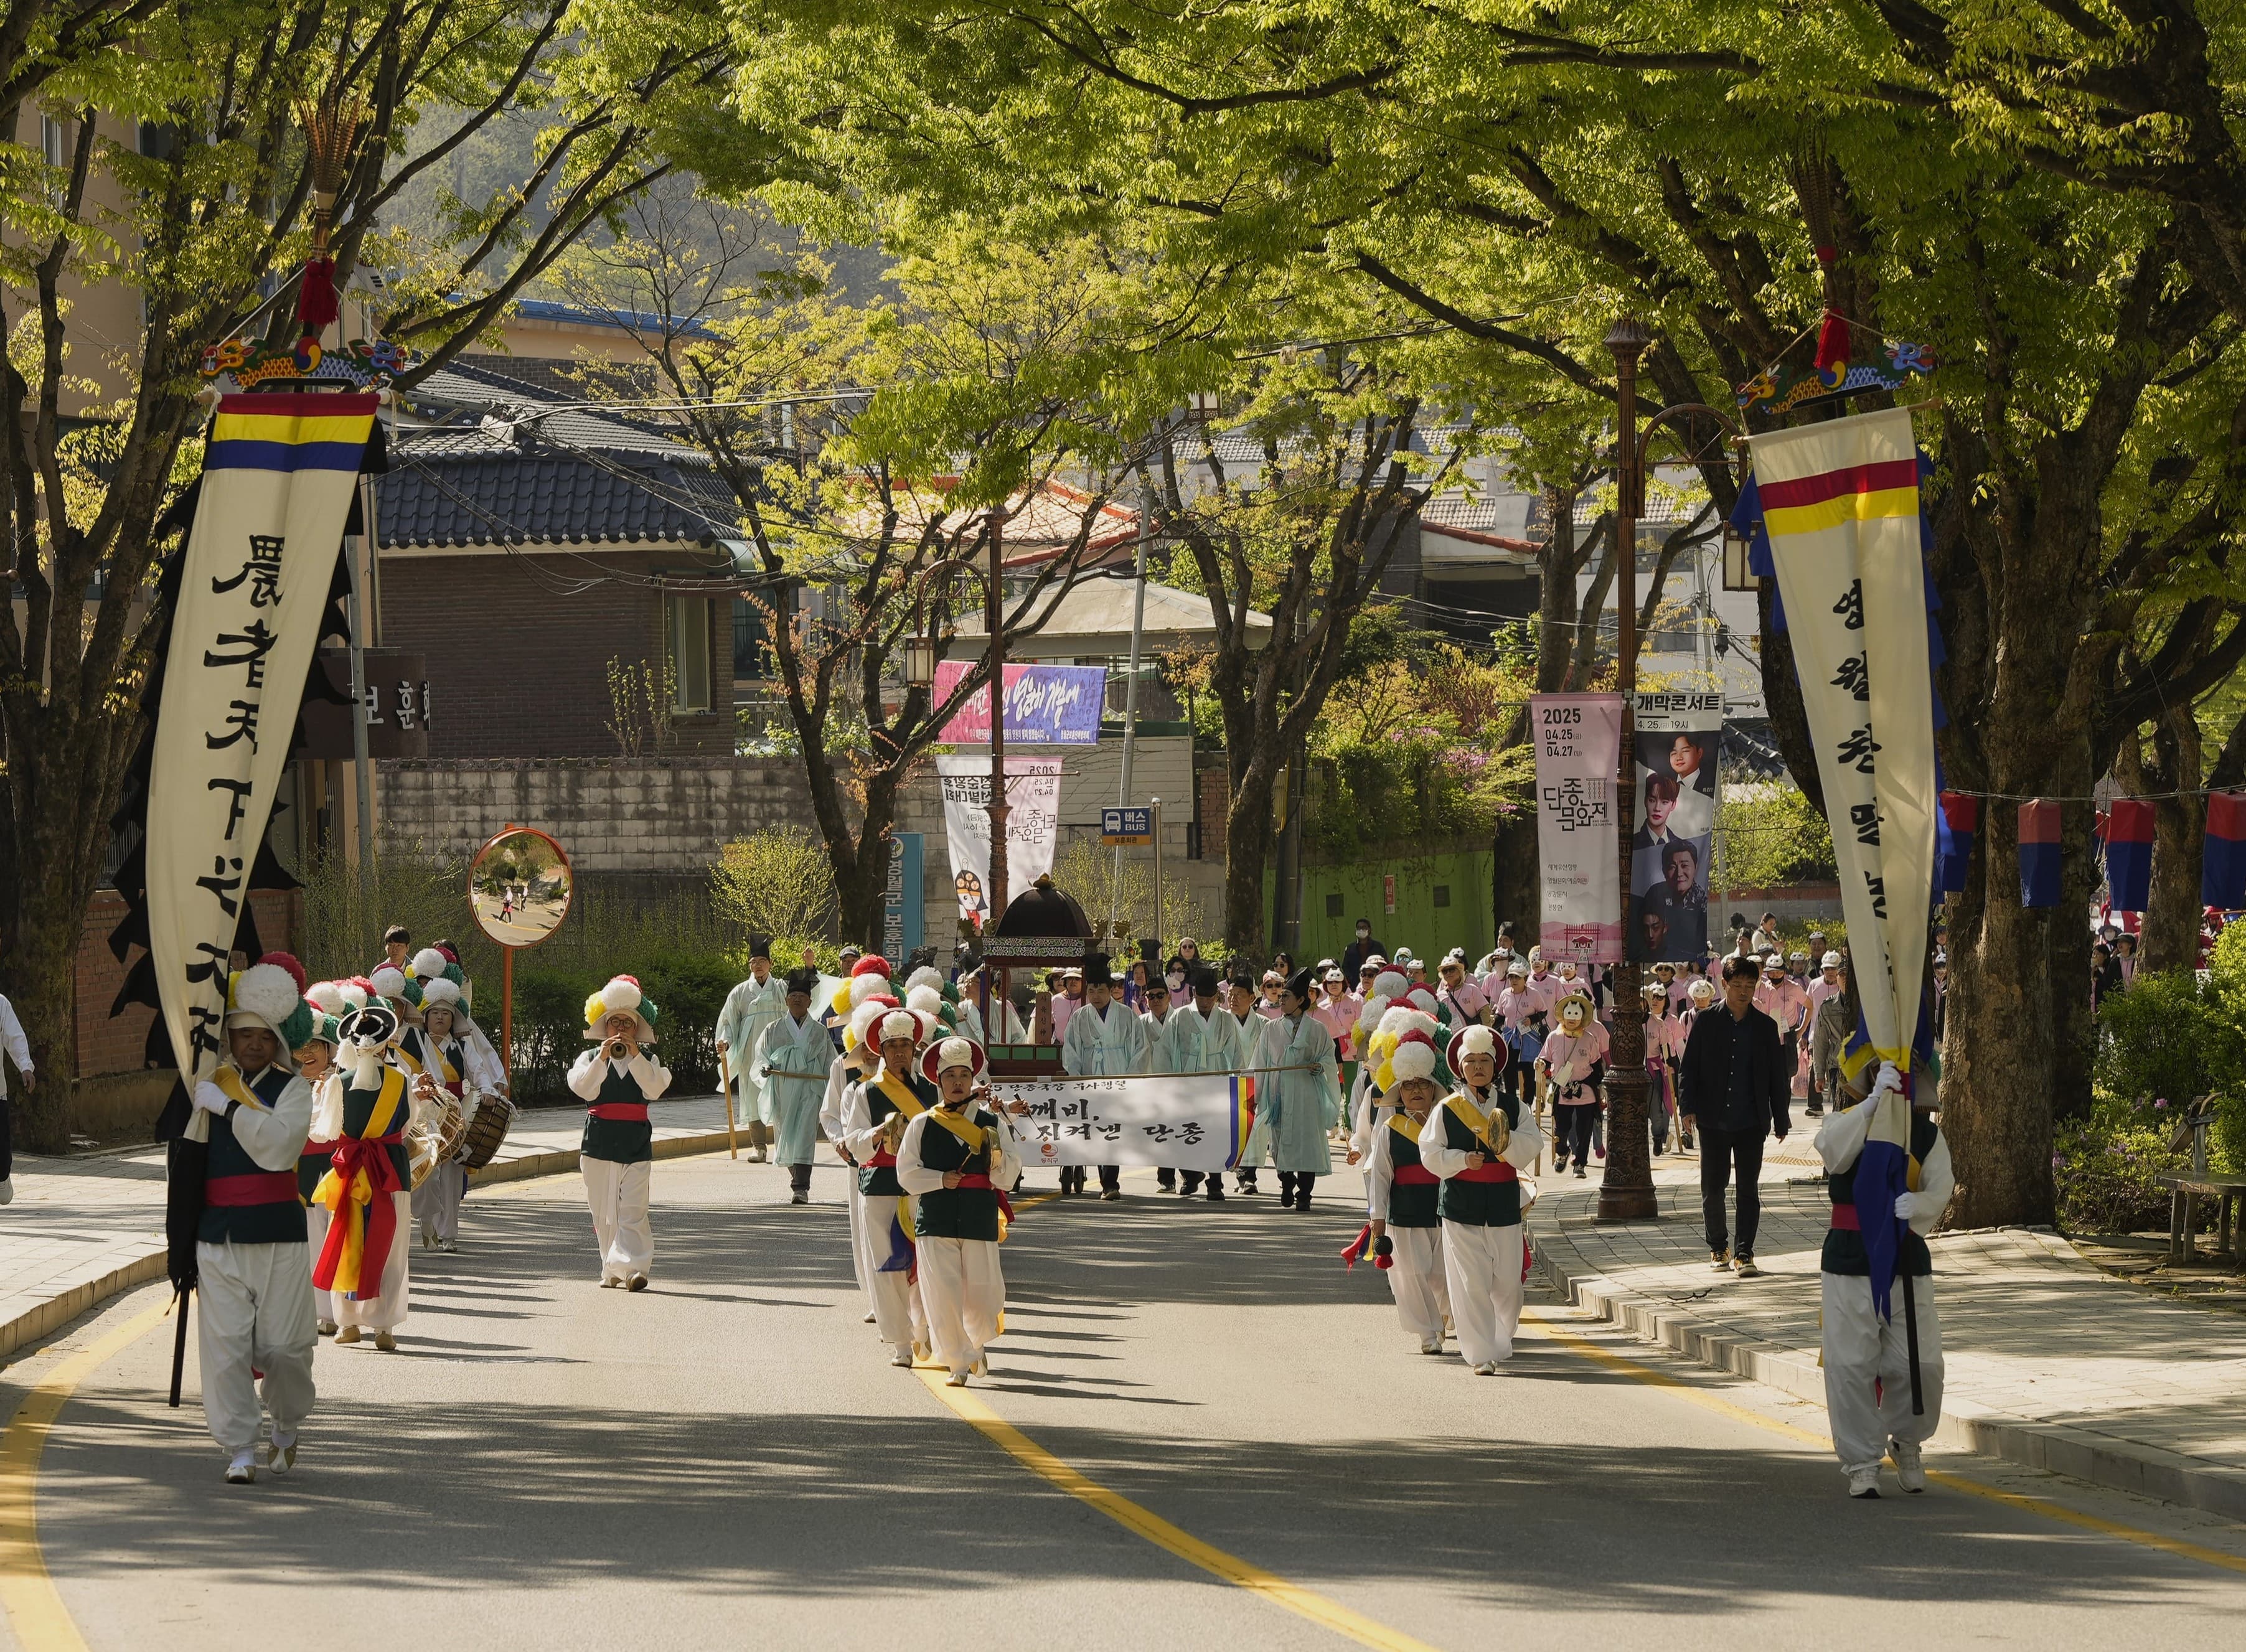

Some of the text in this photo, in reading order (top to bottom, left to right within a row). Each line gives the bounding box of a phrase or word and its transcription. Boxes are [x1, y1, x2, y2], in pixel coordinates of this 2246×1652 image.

[1637, 695, 1720, 711] 개막콘서트
[1543, 708, 1581, 724] 2025
[1671, 721, 1688, 729] 19시
[1125, 812, 1146, 822] 버스
[1018, 1098, 1099, 1121] 깨비,
[1036, 1122, 1122, 1142] 지켜낸
[1142, 1122, 1206, 1145] 단종
